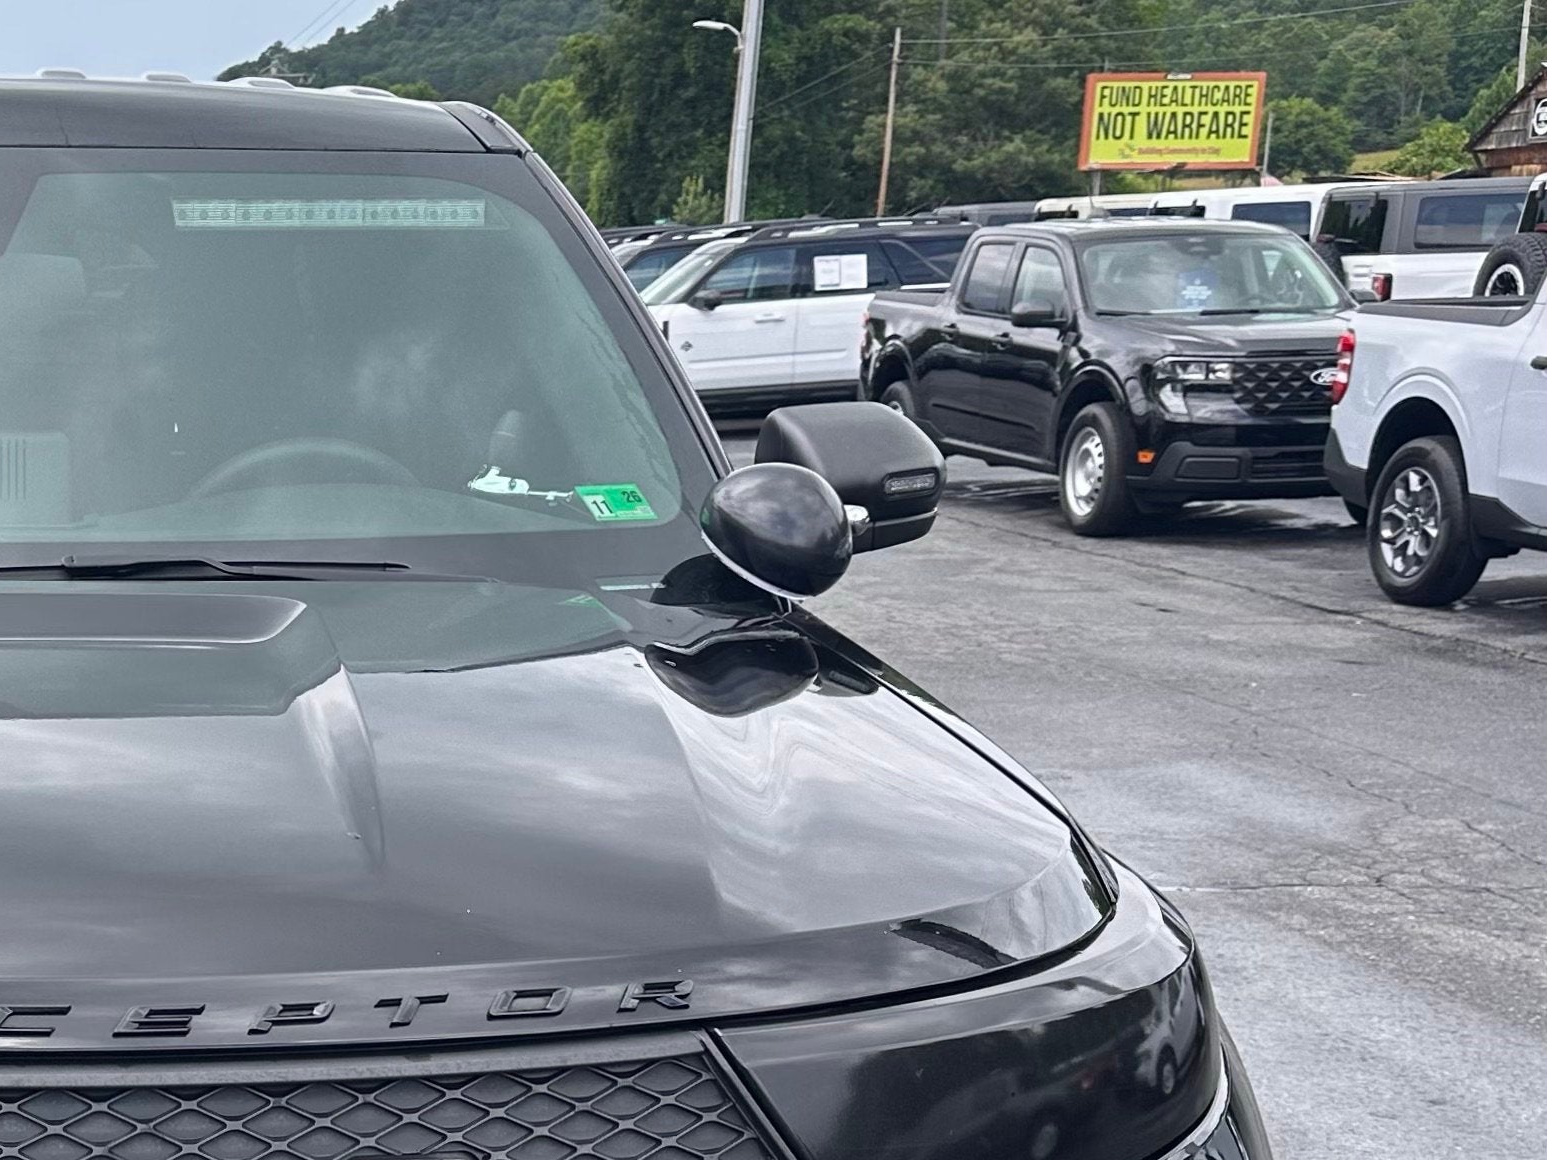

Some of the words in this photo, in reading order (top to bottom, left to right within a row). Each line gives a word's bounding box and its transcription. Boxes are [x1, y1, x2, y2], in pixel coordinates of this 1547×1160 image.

[1098, 85, 1143, 108] FUND
[1146, 84, 1254, 107] HEALTHCARE
[1095, 111, 1141, 141] NOT
[1146, 110, 1252, 140] WARFARE
[621, 490, 643, 503] 26
[591, 500, 614, 515] 11
